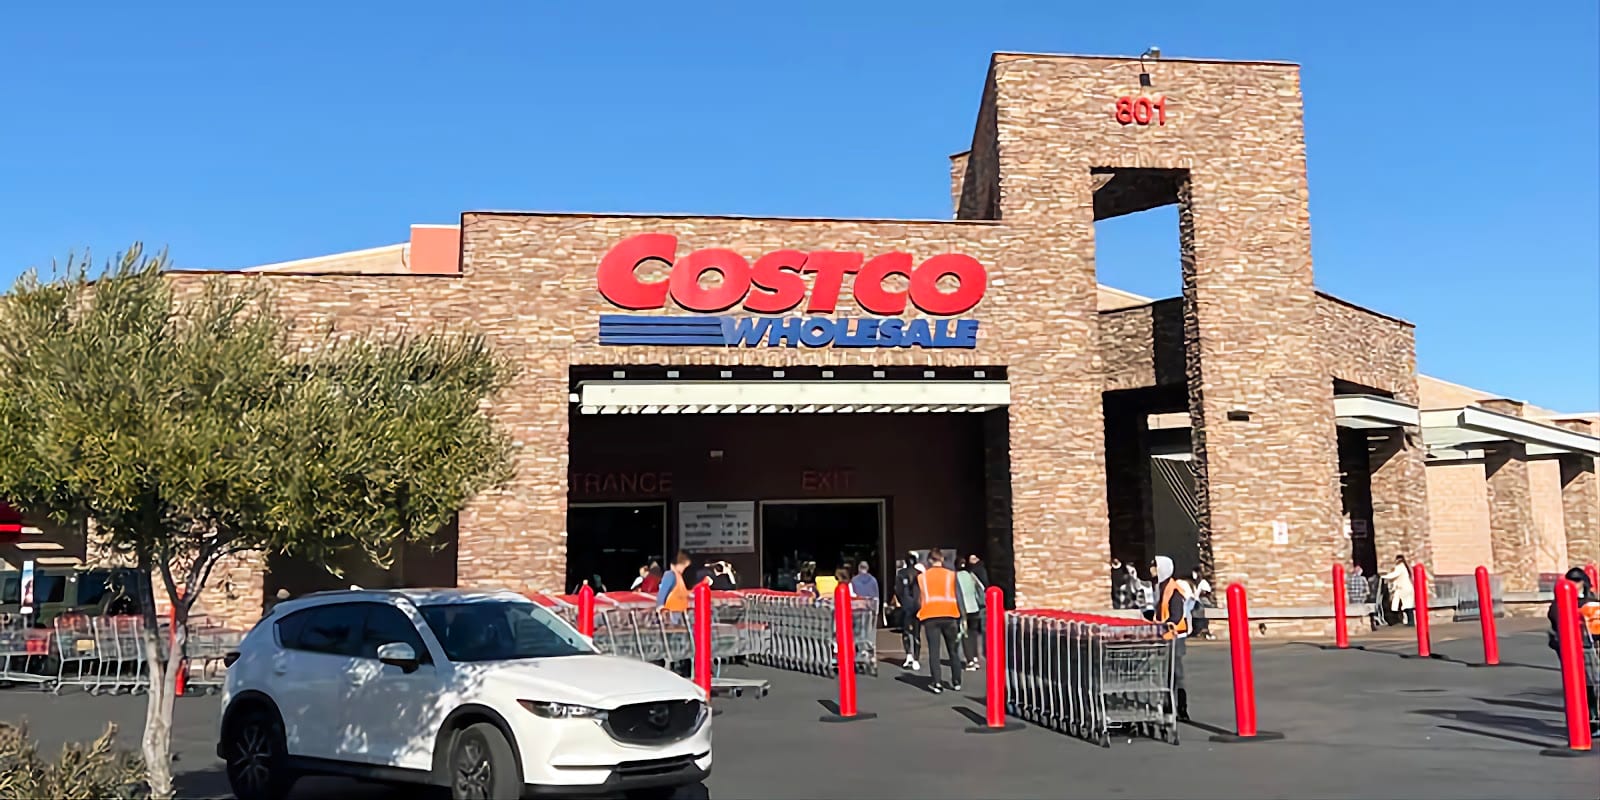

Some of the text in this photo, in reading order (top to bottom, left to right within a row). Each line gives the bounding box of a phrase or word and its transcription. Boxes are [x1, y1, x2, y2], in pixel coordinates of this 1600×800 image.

[1116, 96, 1166, 126] 801
[597, 233, 987, 315] COSTCO
[721, 317, 979, 348] WHOLESALE
[802, 469, 856, 491] EXIT
